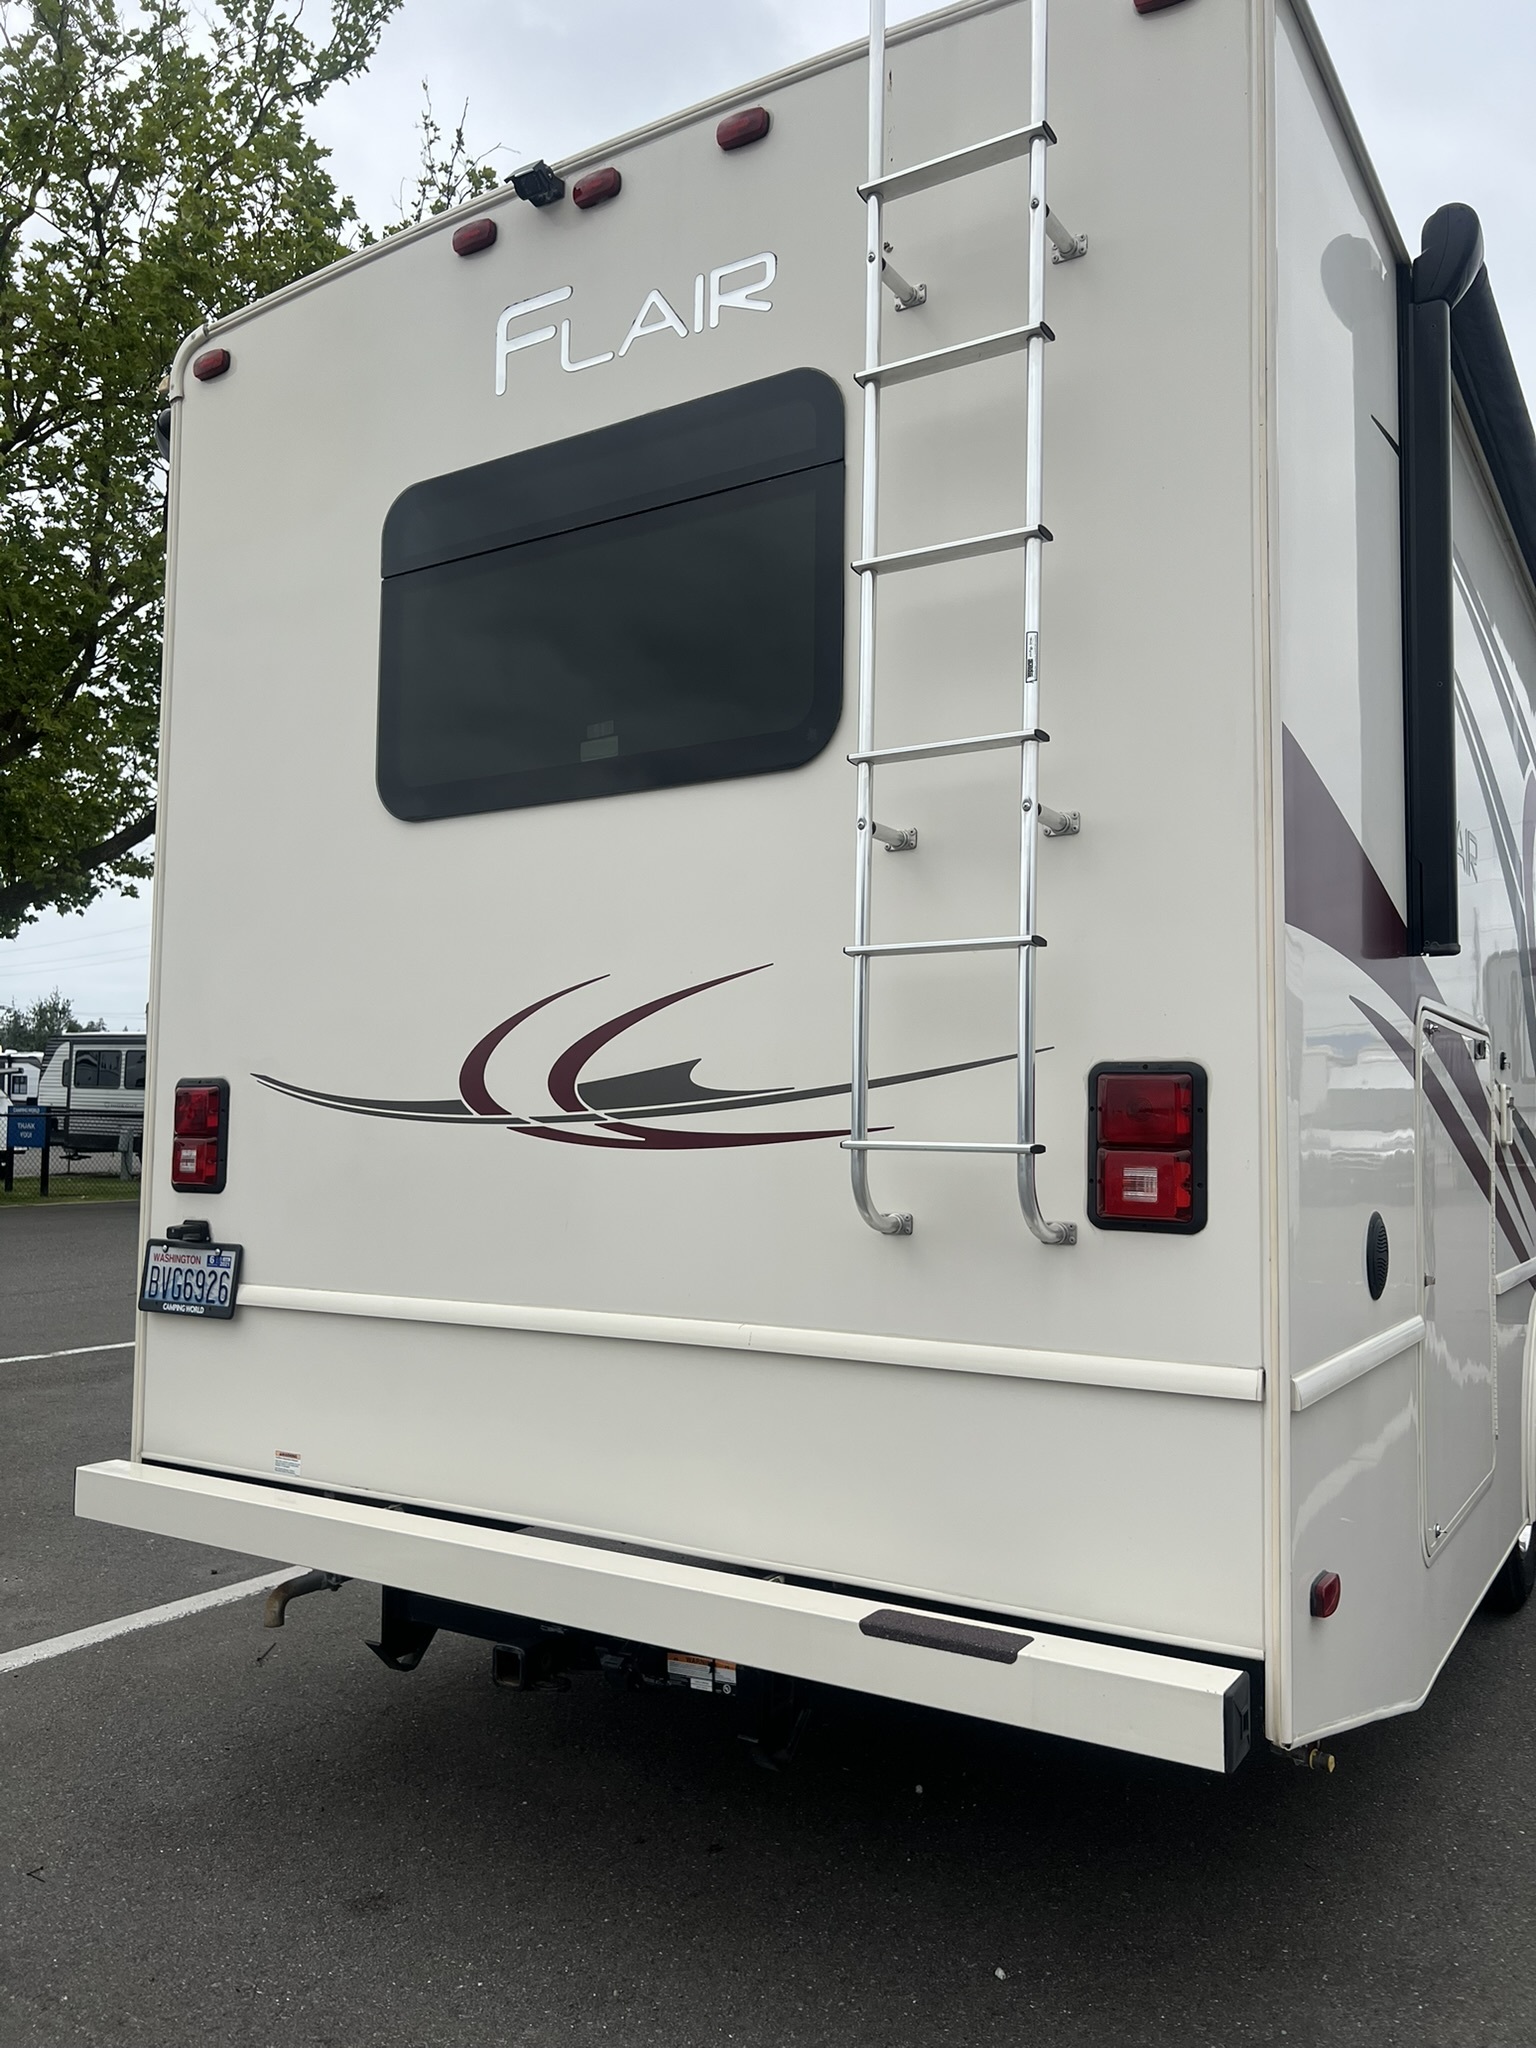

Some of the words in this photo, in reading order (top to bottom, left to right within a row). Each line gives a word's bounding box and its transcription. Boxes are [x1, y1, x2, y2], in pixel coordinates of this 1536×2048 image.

[495, 251, 778, 396] FLAIR
[153, 1253, 202, 1265] WASHINGTON
[148, 1265, 231, 1304] BVG6926
[162, 1302, 186, 1313] CAMPING
[185, 1304, 205, 1314] WORLD
